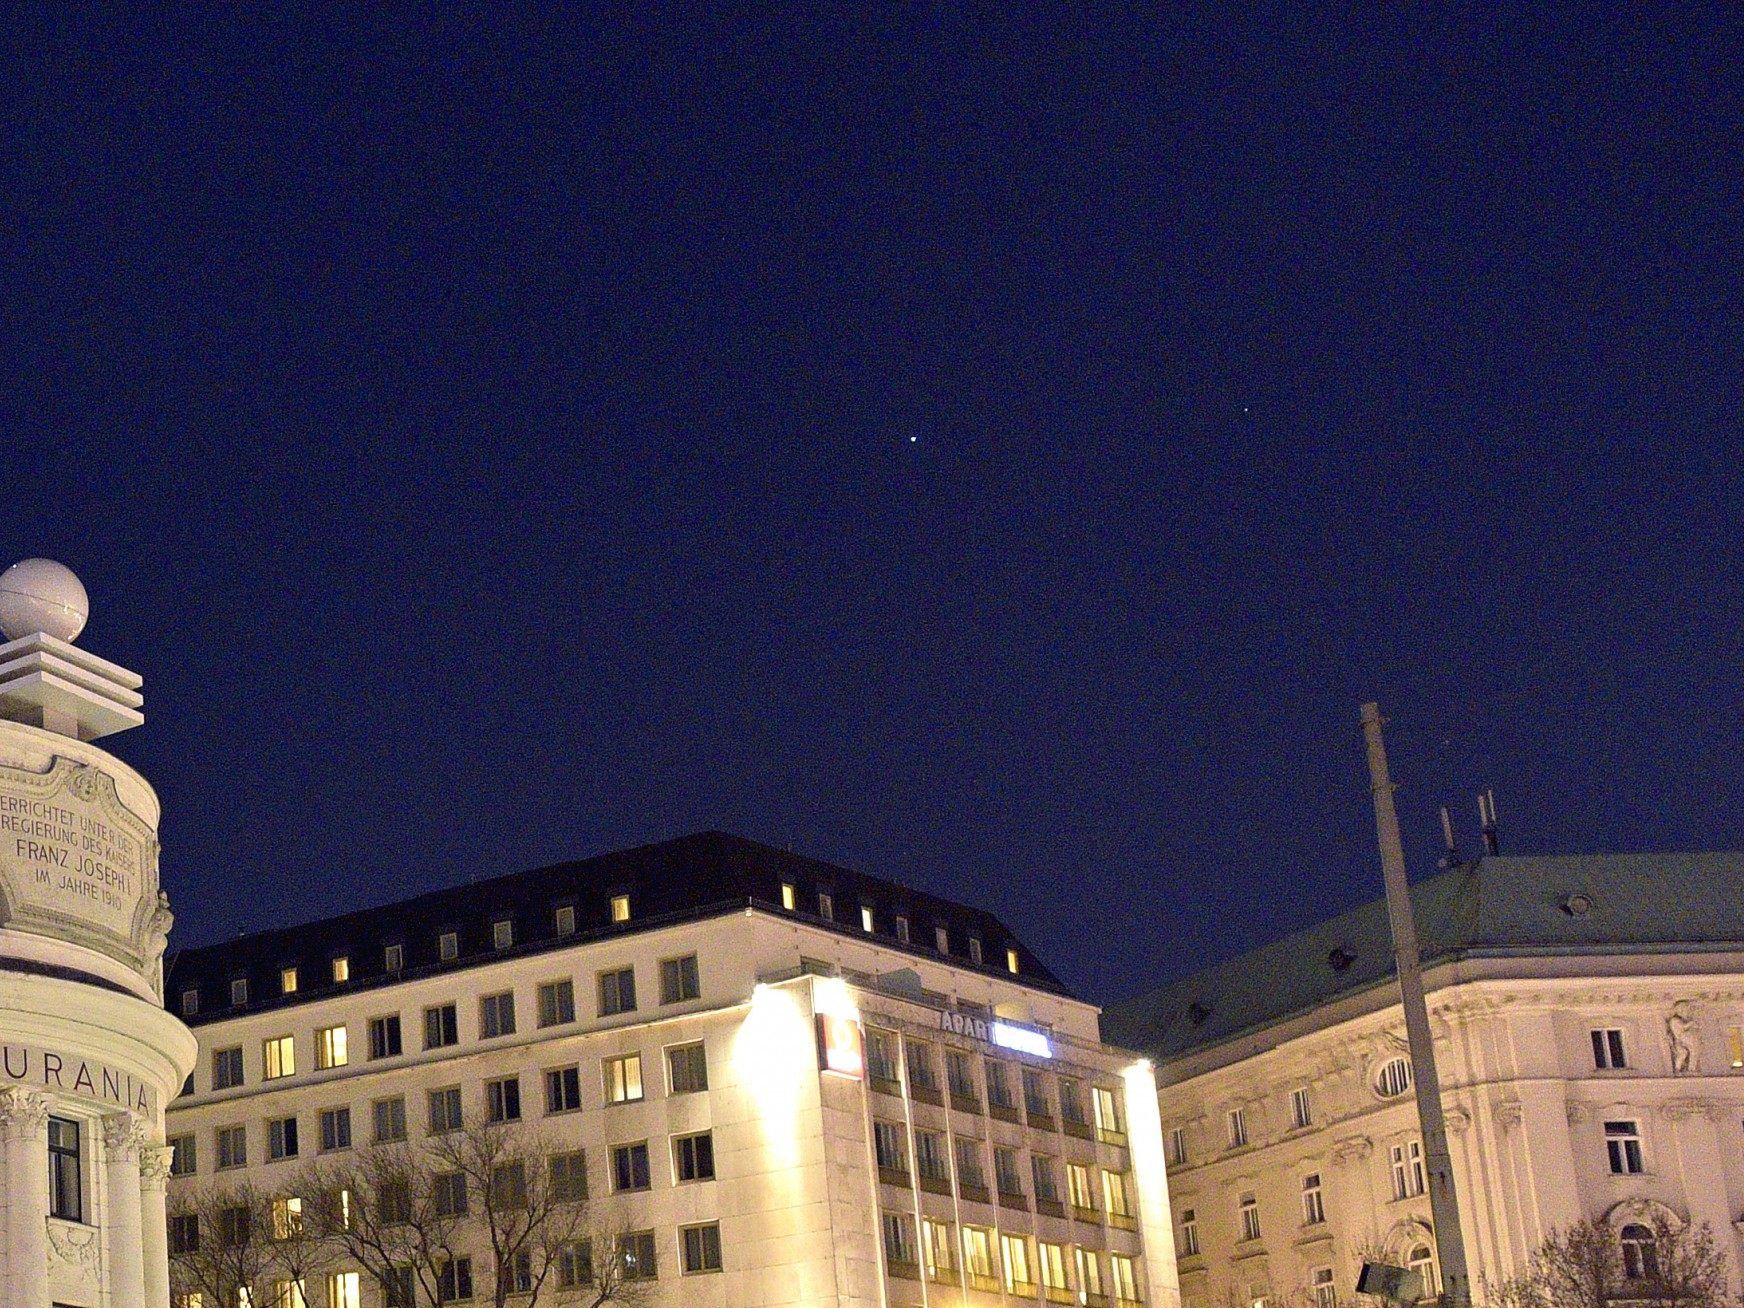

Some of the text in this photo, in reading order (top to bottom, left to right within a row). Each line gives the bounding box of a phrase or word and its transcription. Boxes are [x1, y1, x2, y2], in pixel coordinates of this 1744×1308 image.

[0, 795, 74, 826] ERRICHTET
[80, 816, 115, 843] UNTER
[1, 814, 78, 846] REGIERUNG
[82, 835, 103, 856] DES
[16, 839, 69, 869] FRANZ
[74, 855, 125, 891] JOSEPH
[35, 868, 122, 911] IM JAHRE 1910
[3, 1046, 150, 1117] URANIA
